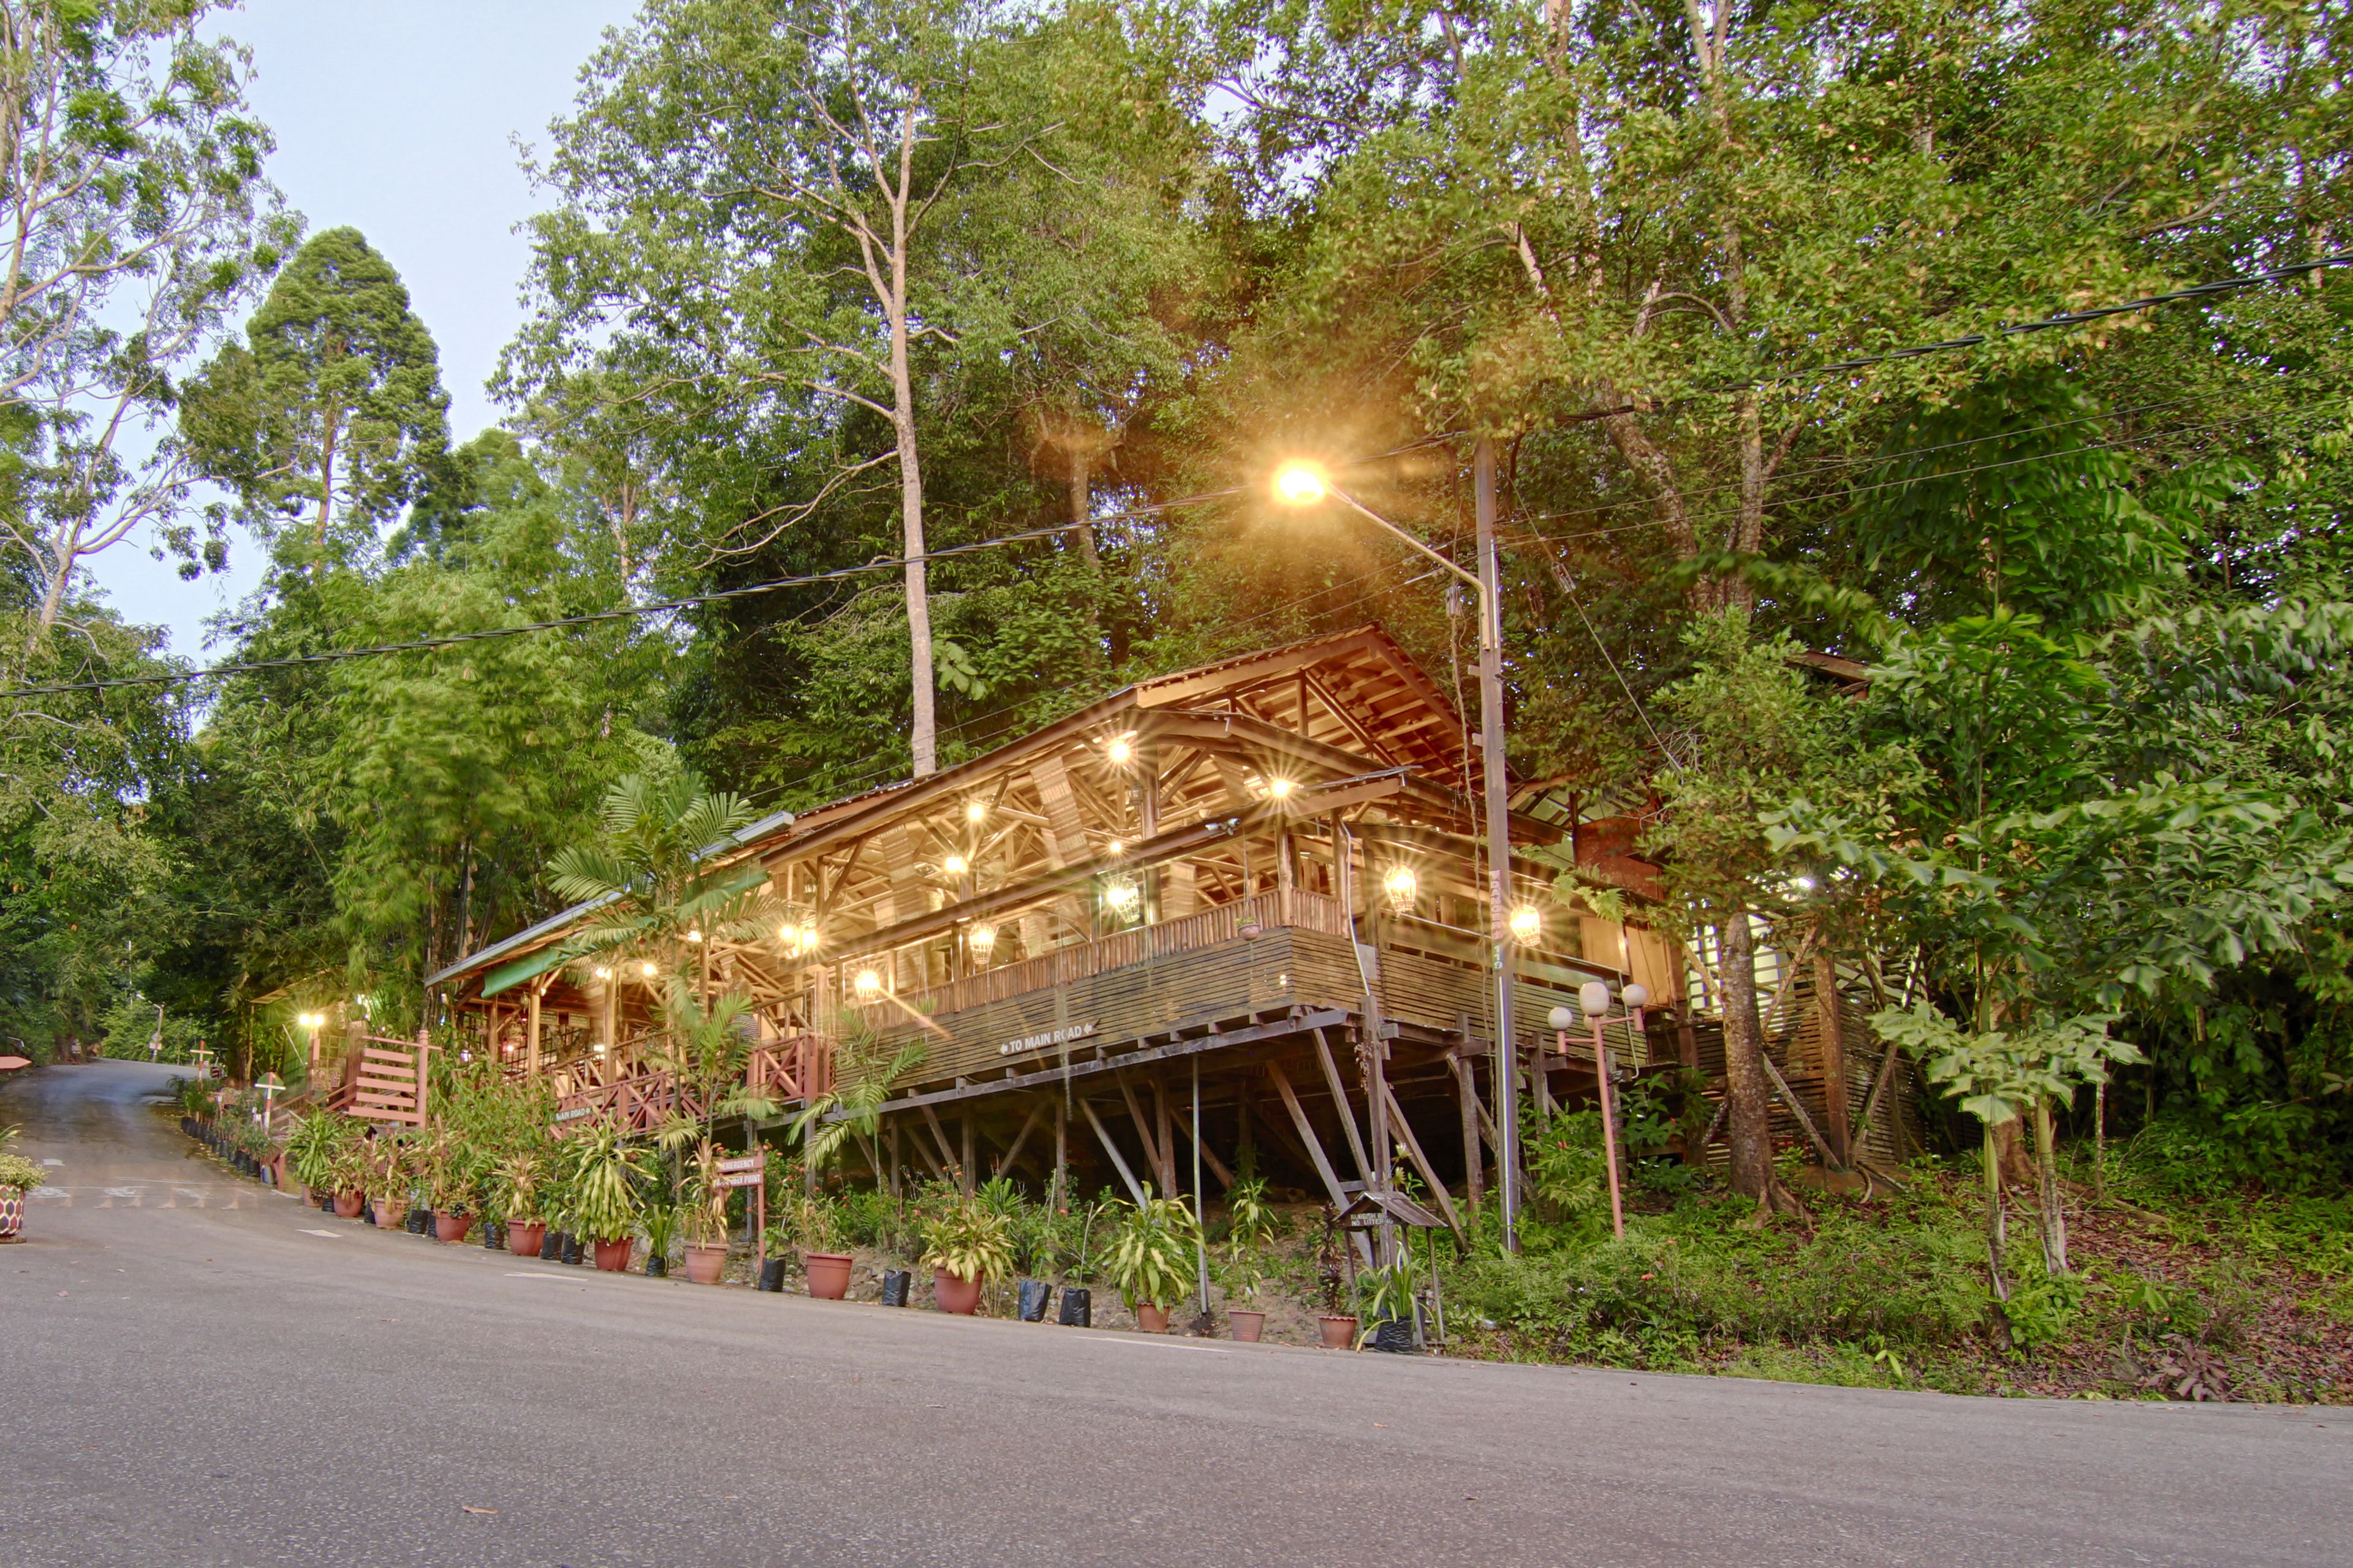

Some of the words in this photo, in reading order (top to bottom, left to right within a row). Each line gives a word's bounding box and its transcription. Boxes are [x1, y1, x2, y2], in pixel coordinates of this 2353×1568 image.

[1010, 1040, 1022, 1052] TO
[1025, 1032, 1050, 1049] MAIN
[570, 1108, 585, 1118] ROAD
[722, 1159, 754, 1170] EMERGENCY
[744, 1174, 760, 1184] POINT
